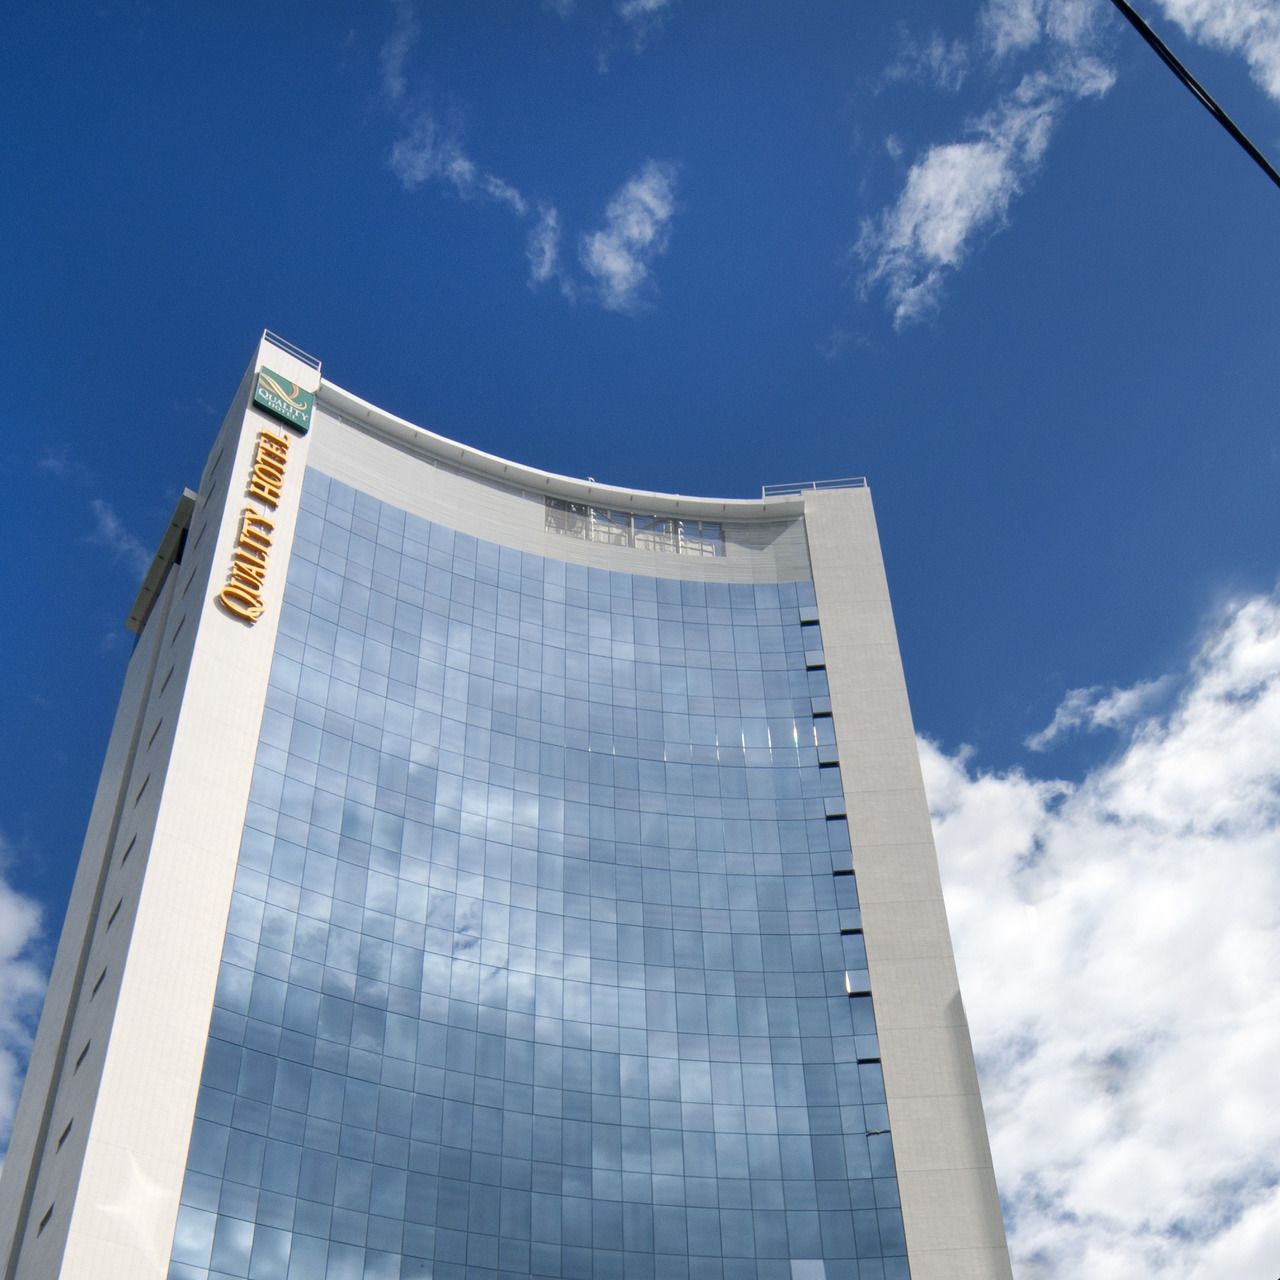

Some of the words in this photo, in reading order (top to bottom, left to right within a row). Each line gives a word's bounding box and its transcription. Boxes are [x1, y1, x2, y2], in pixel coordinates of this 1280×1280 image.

[258, 387, 308, 421] QUALITY
[220, 505, 277, 623] QUALITY
[250, 428, 292, 510] HOTEL
